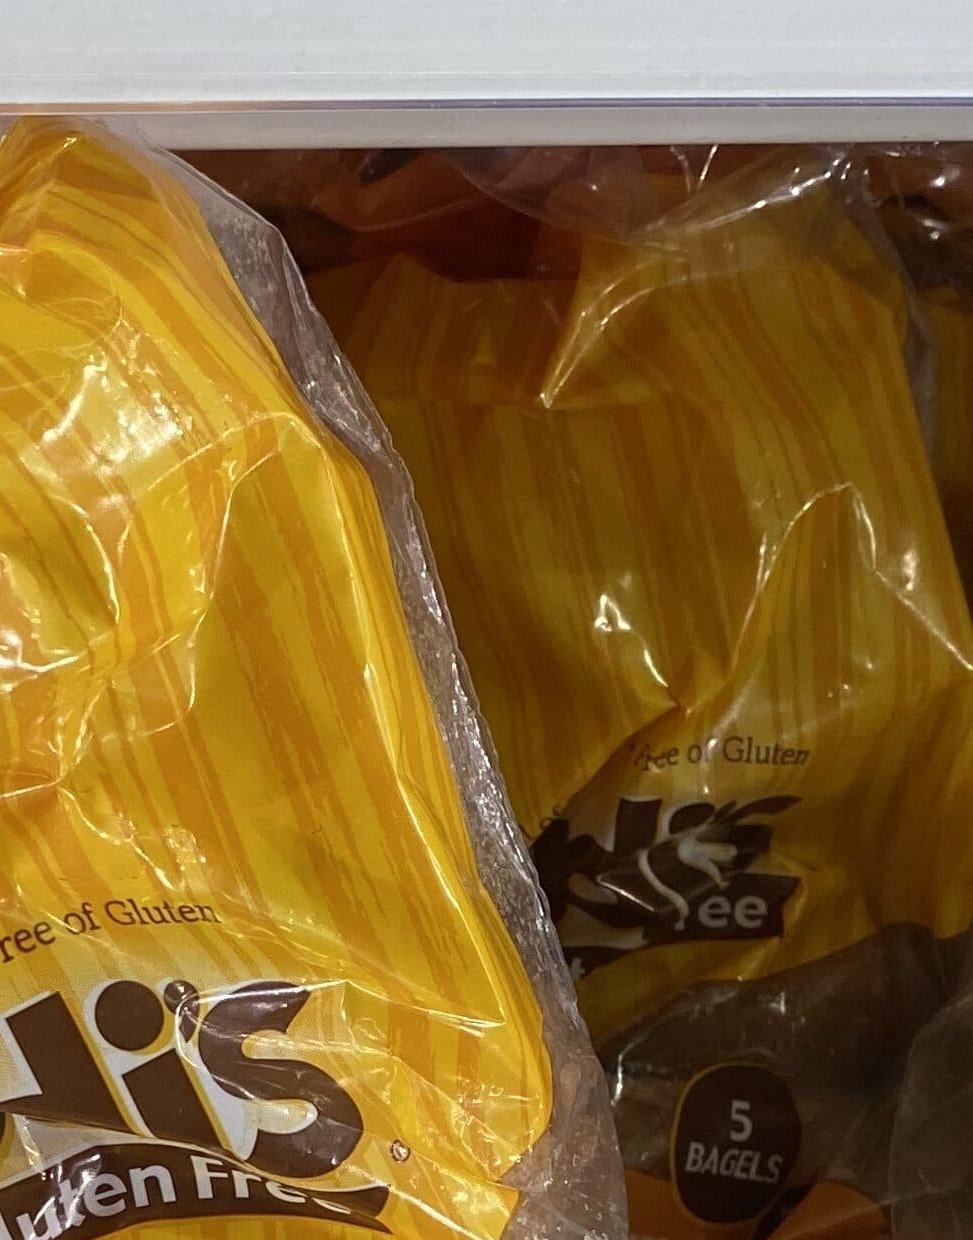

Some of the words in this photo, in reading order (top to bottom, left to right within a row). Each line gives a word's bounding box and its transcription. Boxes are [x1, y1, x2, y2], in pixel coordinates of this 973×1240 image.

[723, 736, 811, 767] Gluten
[65, 903, 101, 936] of
[105, 899, 222, 926] Gluten
[729, 1100, 754, 1143] 5
[685, 1142, 784, 1184] BAGELS
